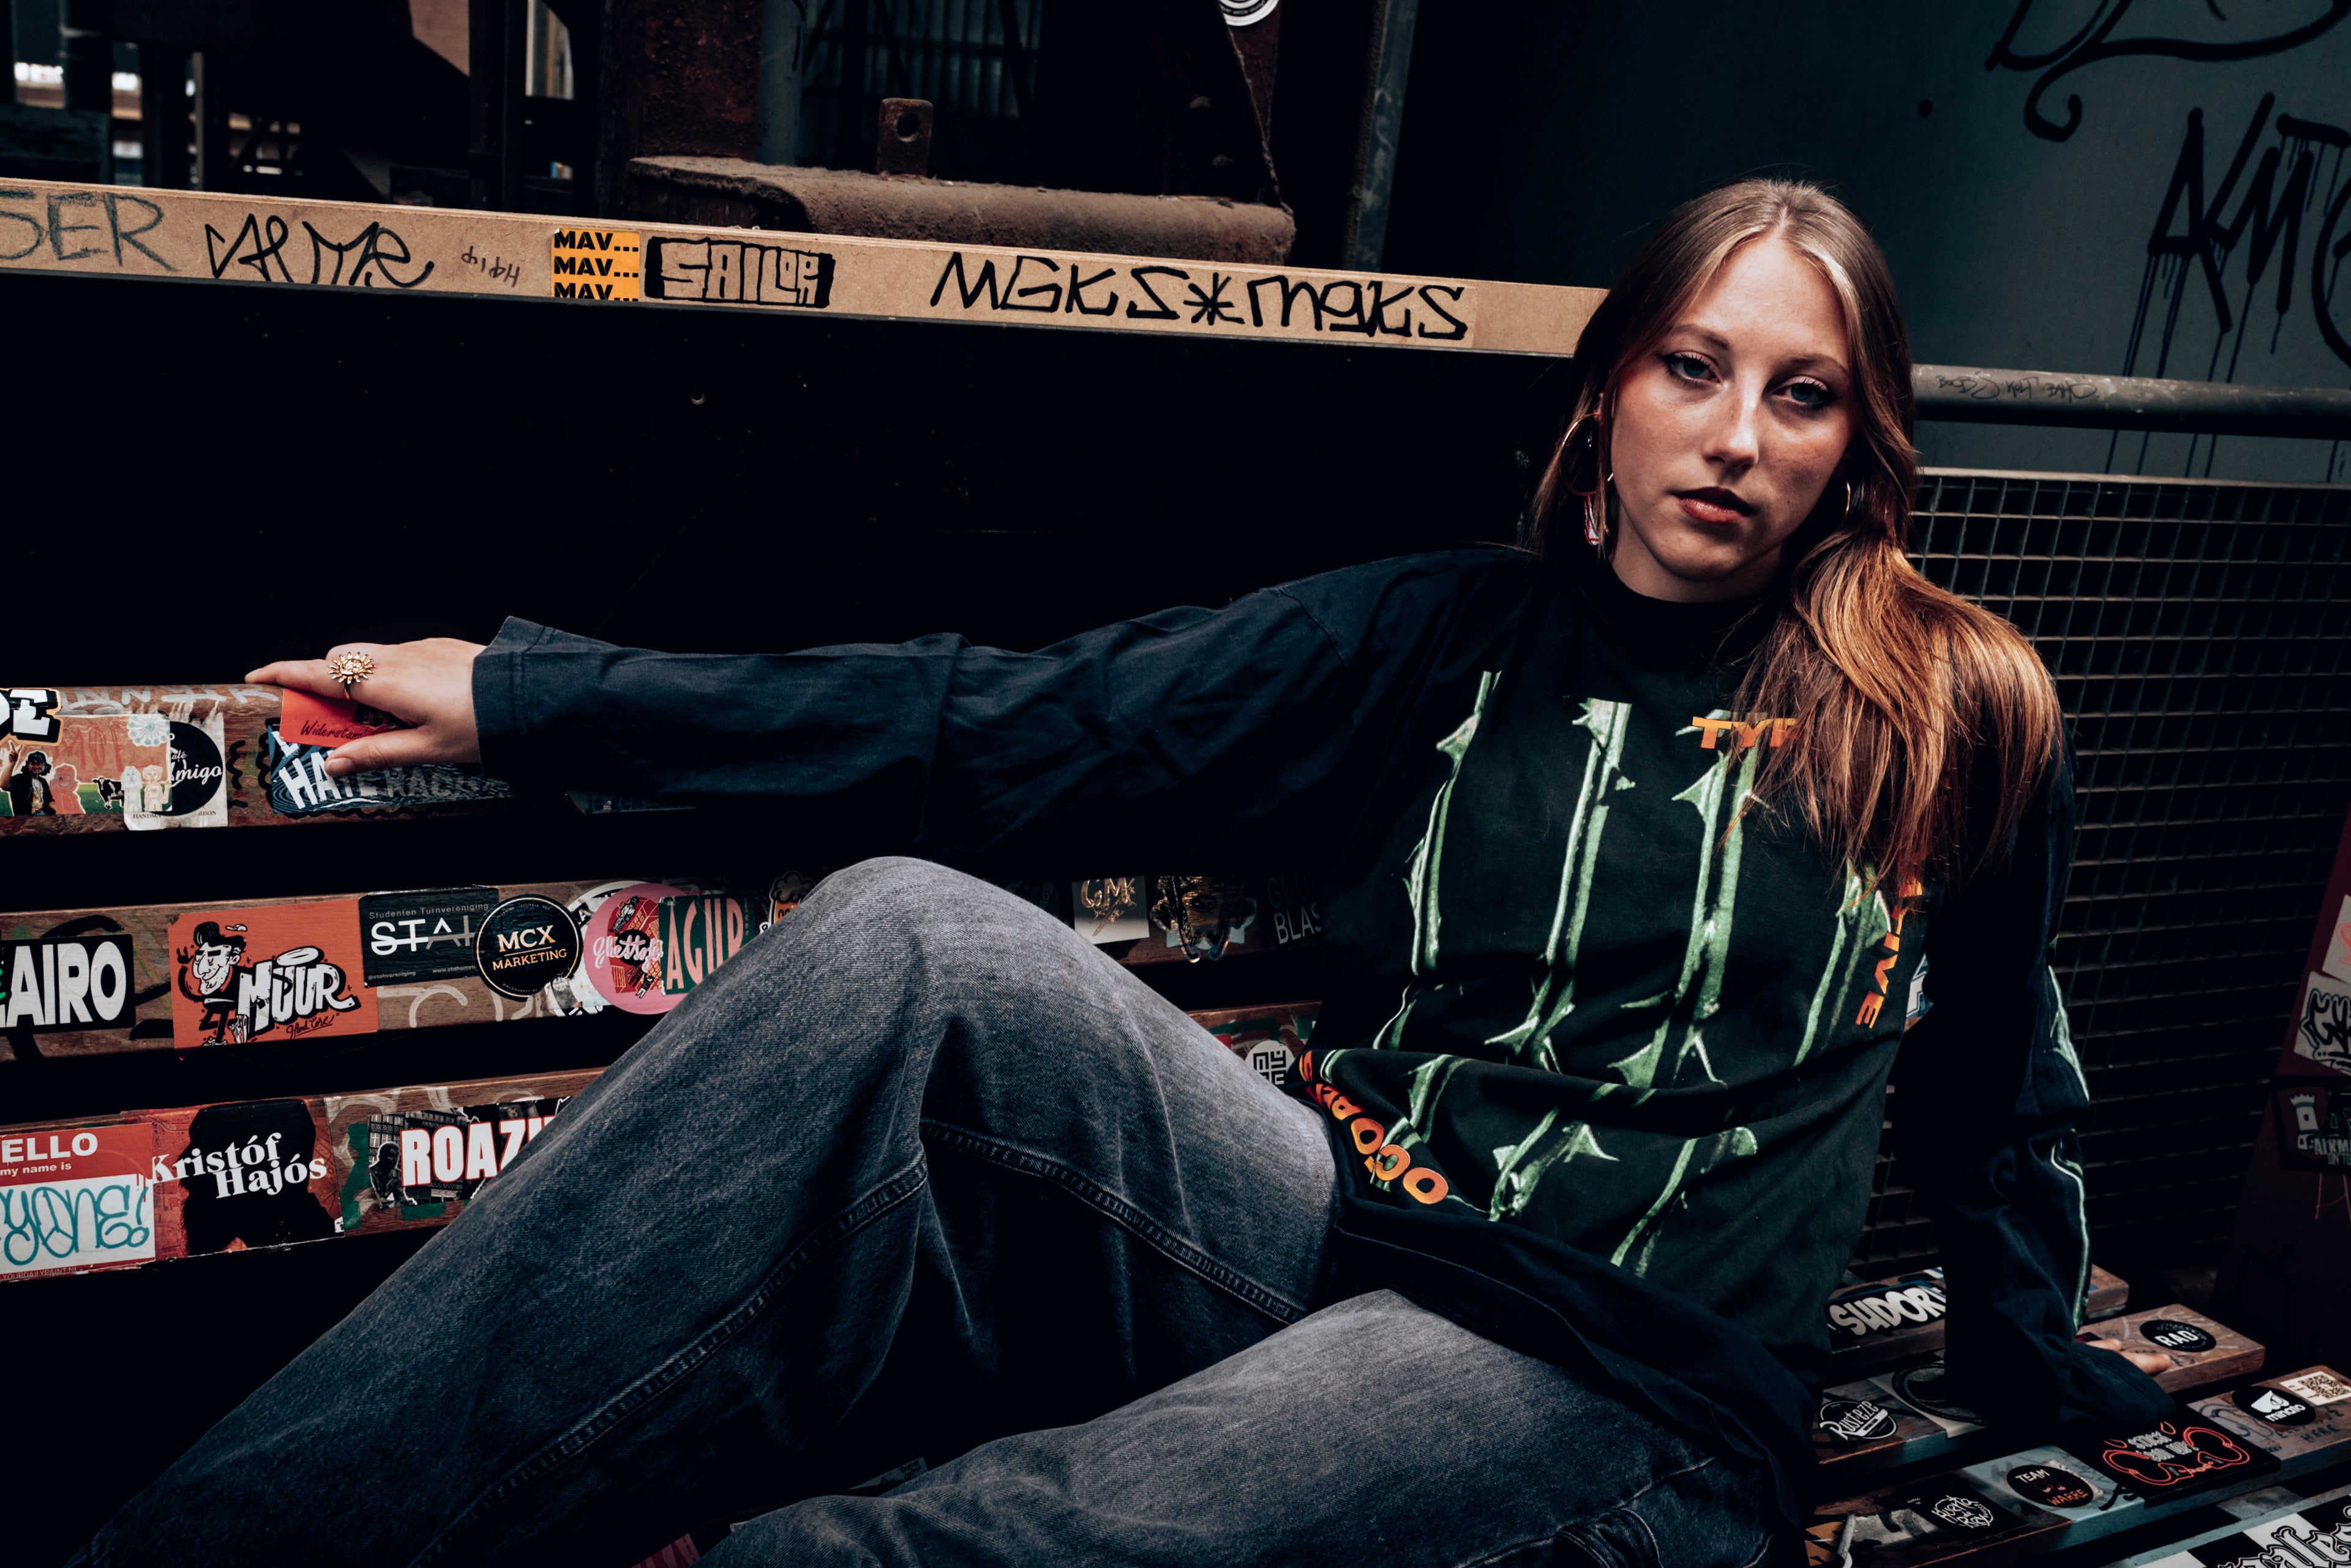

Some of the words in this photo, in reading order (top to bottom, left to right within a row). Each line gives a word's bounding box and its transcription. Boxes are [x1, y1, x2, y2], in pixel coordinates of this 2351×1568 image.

[369, 909, 416, 920] Studenten
[421, 902, 489, 916] Turnvereniging
[497, 924, 556, 953] MCX
[492, 948, 568, 971] MARKETING
[1, 1132, 99, 1163] ELLO
[152, 1131, 283, 1184] Kristóf
[22, 1165, 58, 1175] name
[60, 1161, 72, 1171] is
[216, 1153, 328, 1199] Hajós
[2153, 1330, 2200, 1347] RAD
[2014, 1469, 2050, 1484] TEAM
[2045, 1488, 2090, 1507] WARRE
